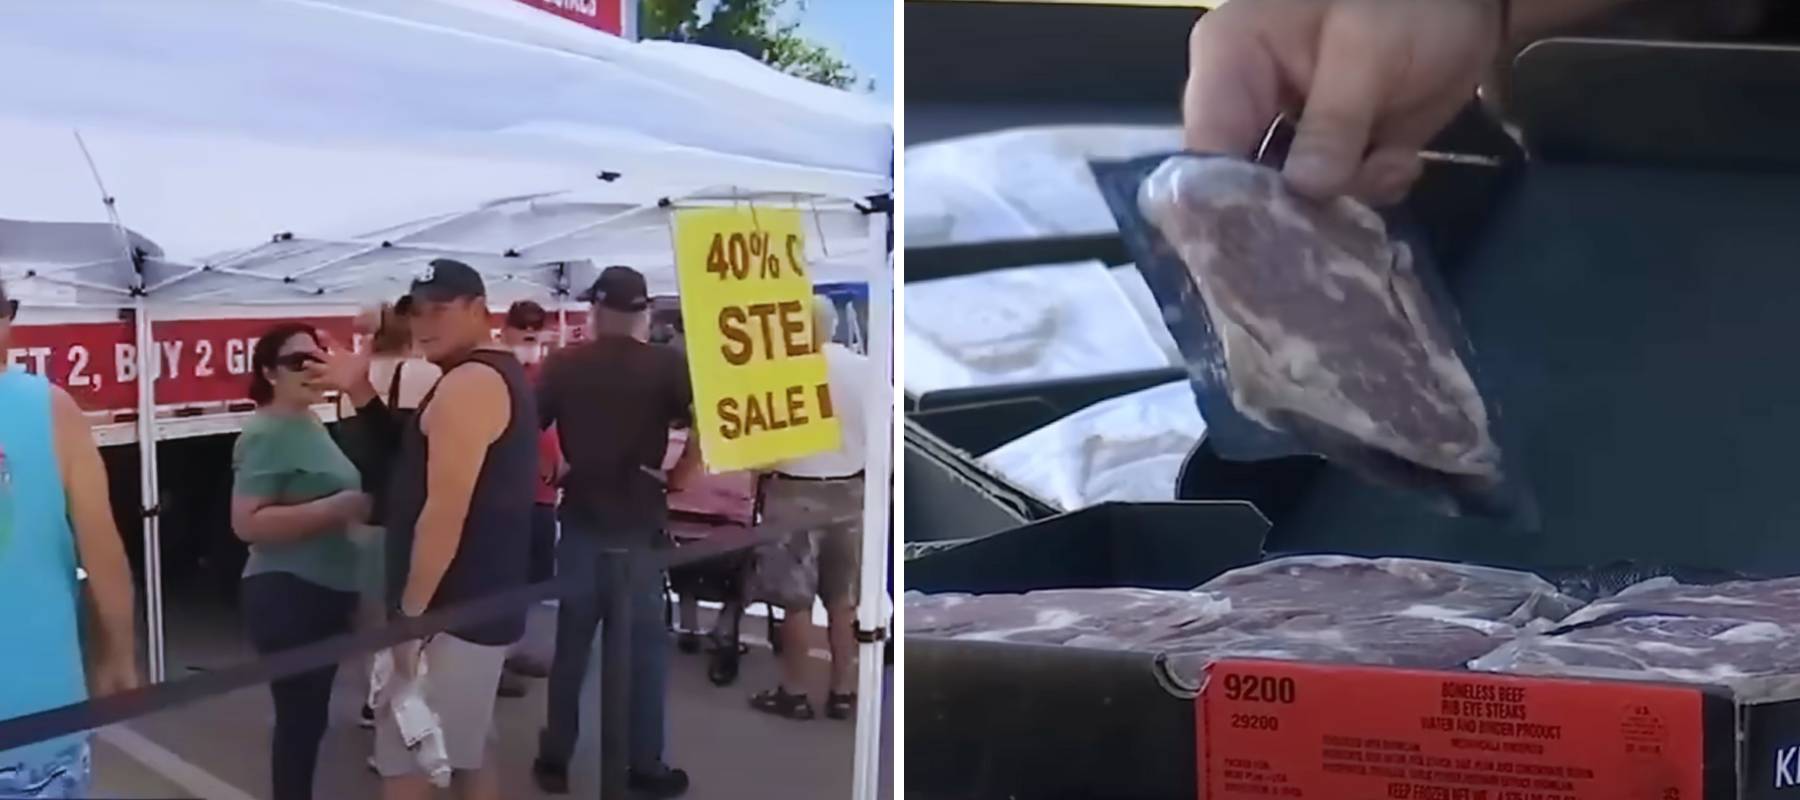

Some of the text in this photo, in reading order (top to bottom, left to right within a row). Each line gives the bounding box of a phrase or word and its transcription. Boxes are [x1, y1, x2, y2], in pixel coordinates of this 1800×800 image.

[707, 232, 780, 280] 40%
[67, 344, 103, 391] 2,
[195, 339, 215, 377] 2
[717, 385, 809, 440] SALE
[1223, 673, 1296, 704] 9200
[1441, 682, 1526, 703] BONELESS BEEF
[1231, 713, 1279, 732] 29200
[1463, 701, 1483, 717] EYE
[1486, 702, 1526, 720] STEAKS
[1420, 716, 1454, 732] WATER
[1456, 718, 1476, 733] AND
[1516, 723, 1562, 740] PRODUCT
